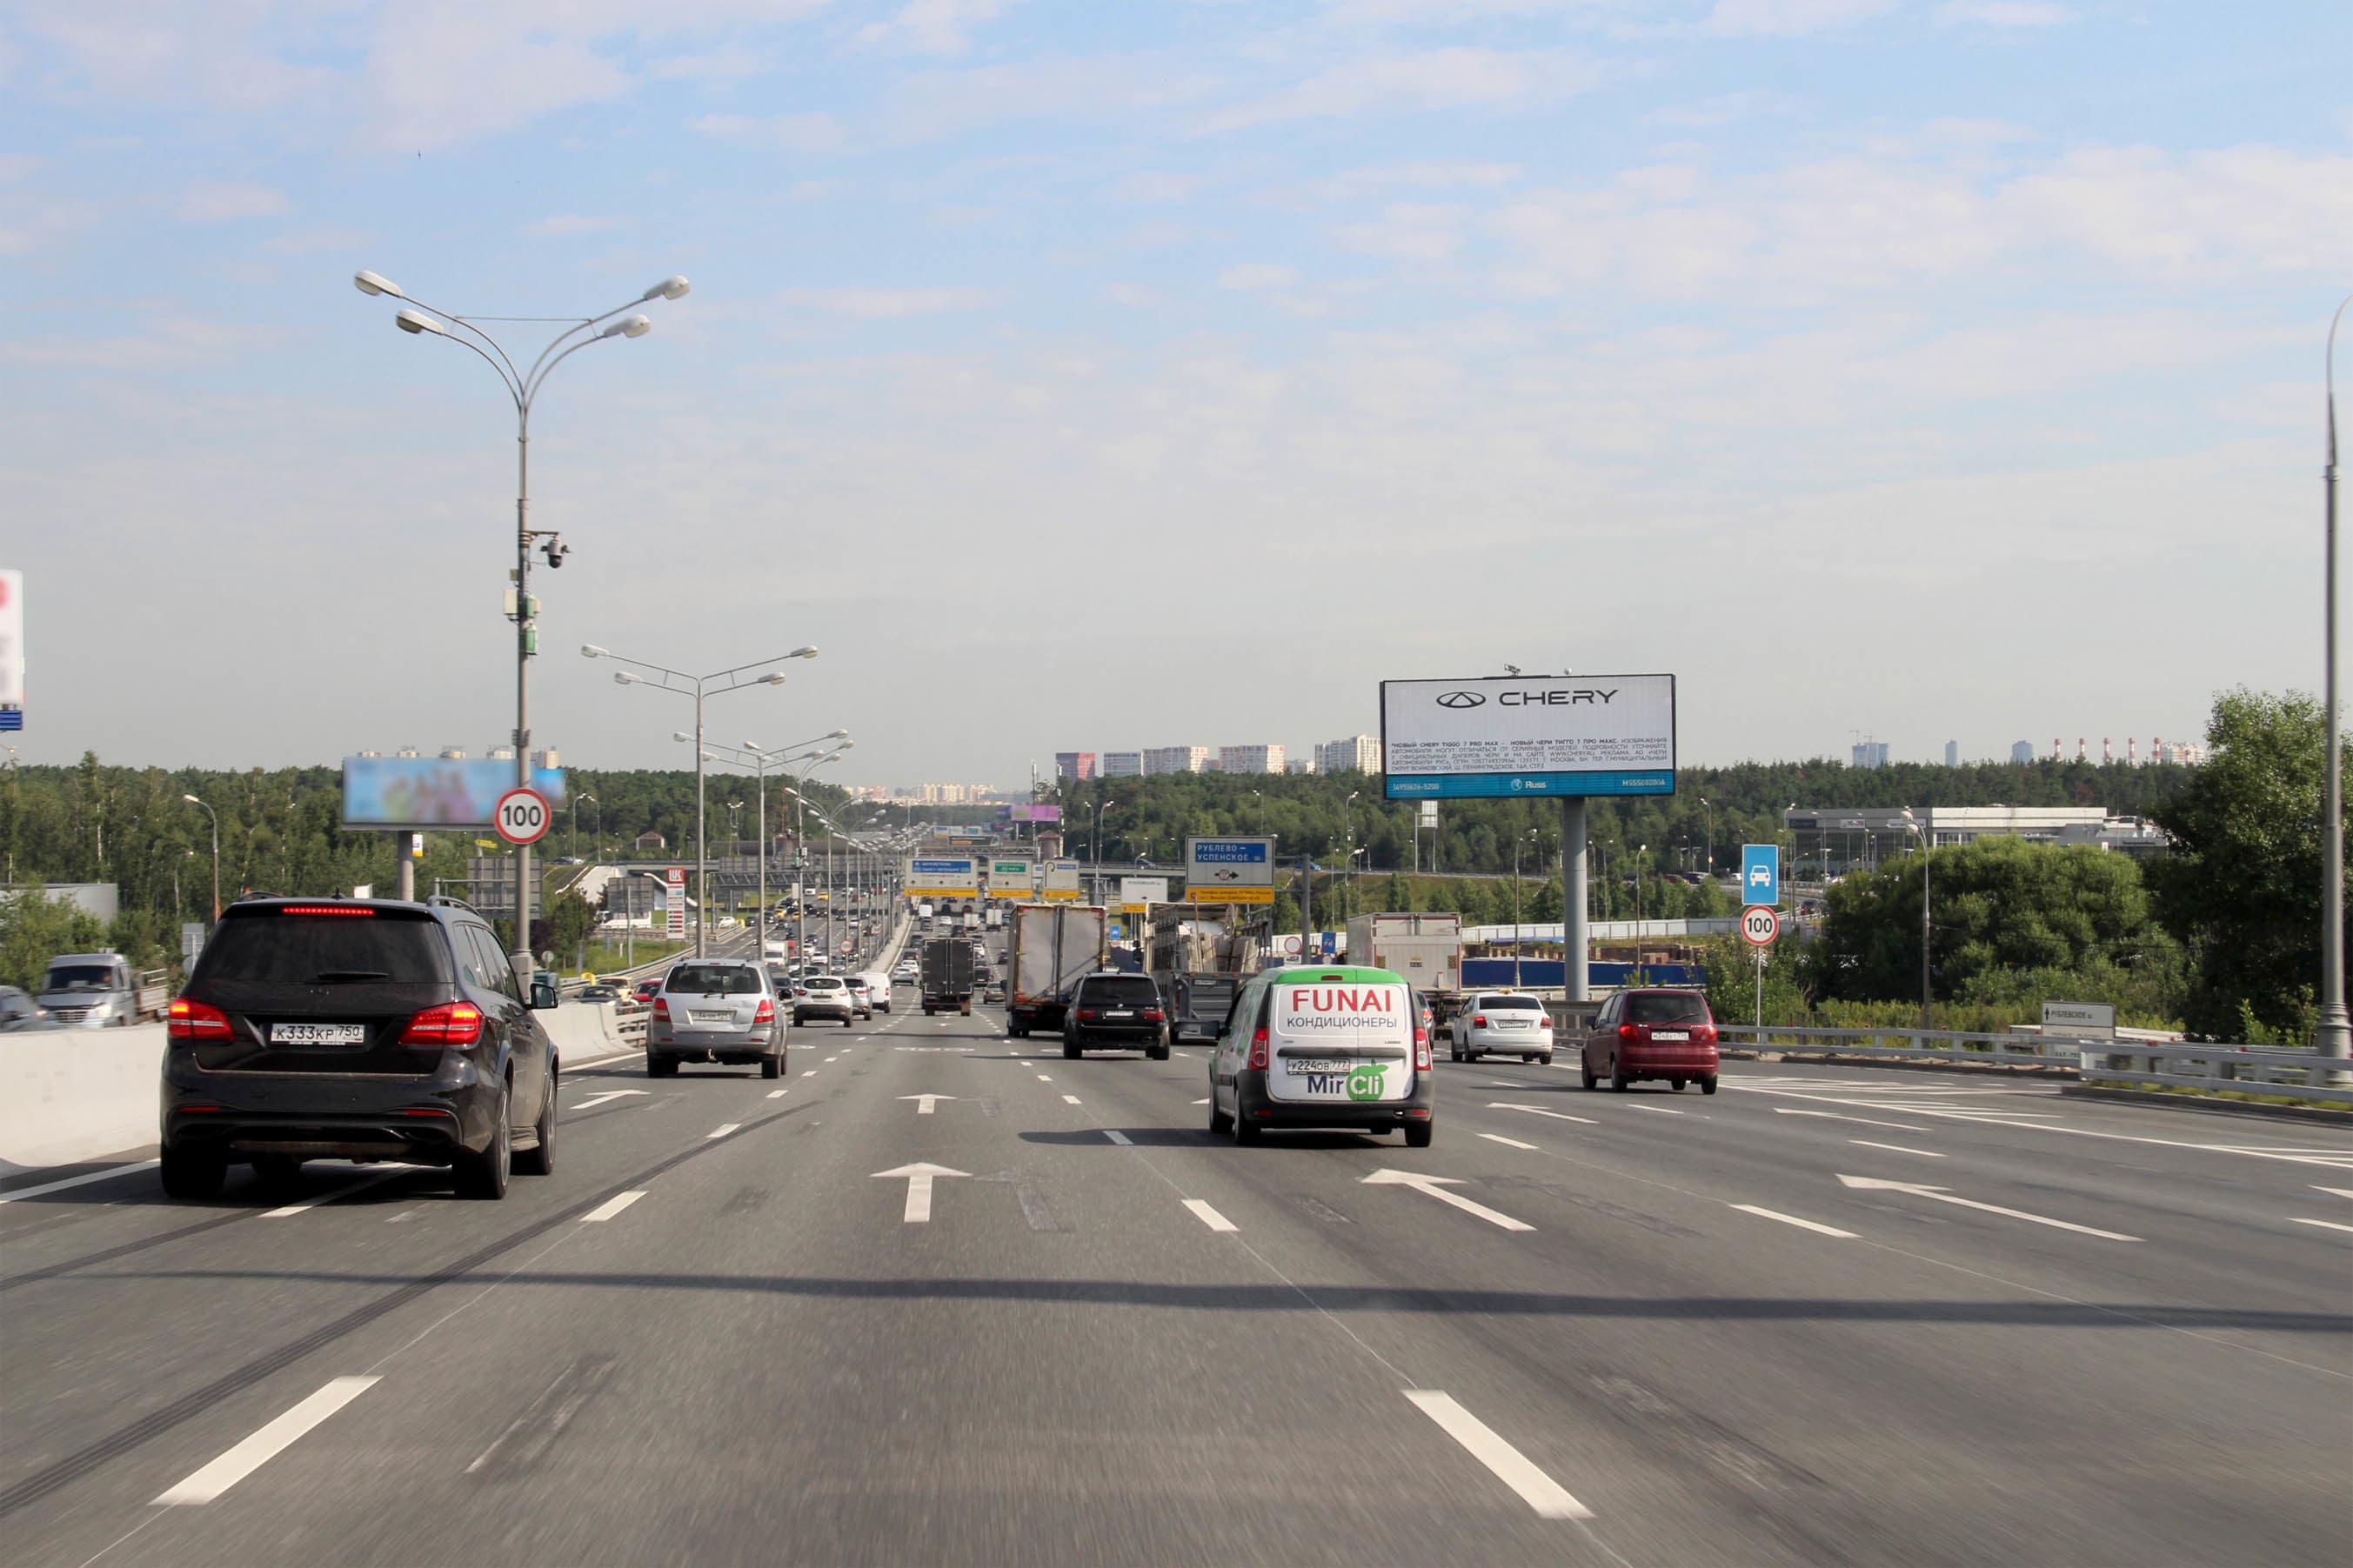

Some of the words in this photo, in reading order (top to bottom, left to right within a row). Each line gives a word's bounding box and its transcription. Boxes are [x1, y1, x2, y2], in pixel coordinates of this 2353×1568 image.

[1499, 690, 1619, 705] CHERY
[503, 805, 540, 827] 100
[1747, 917, 1773, 933] 100
[1293, 989, 1391, 1012] FUNAI
[1287, 1017, 1398, 1028] КОНДИЦИОНЕРЫ
[336, 1025, 360, 1037] 750
